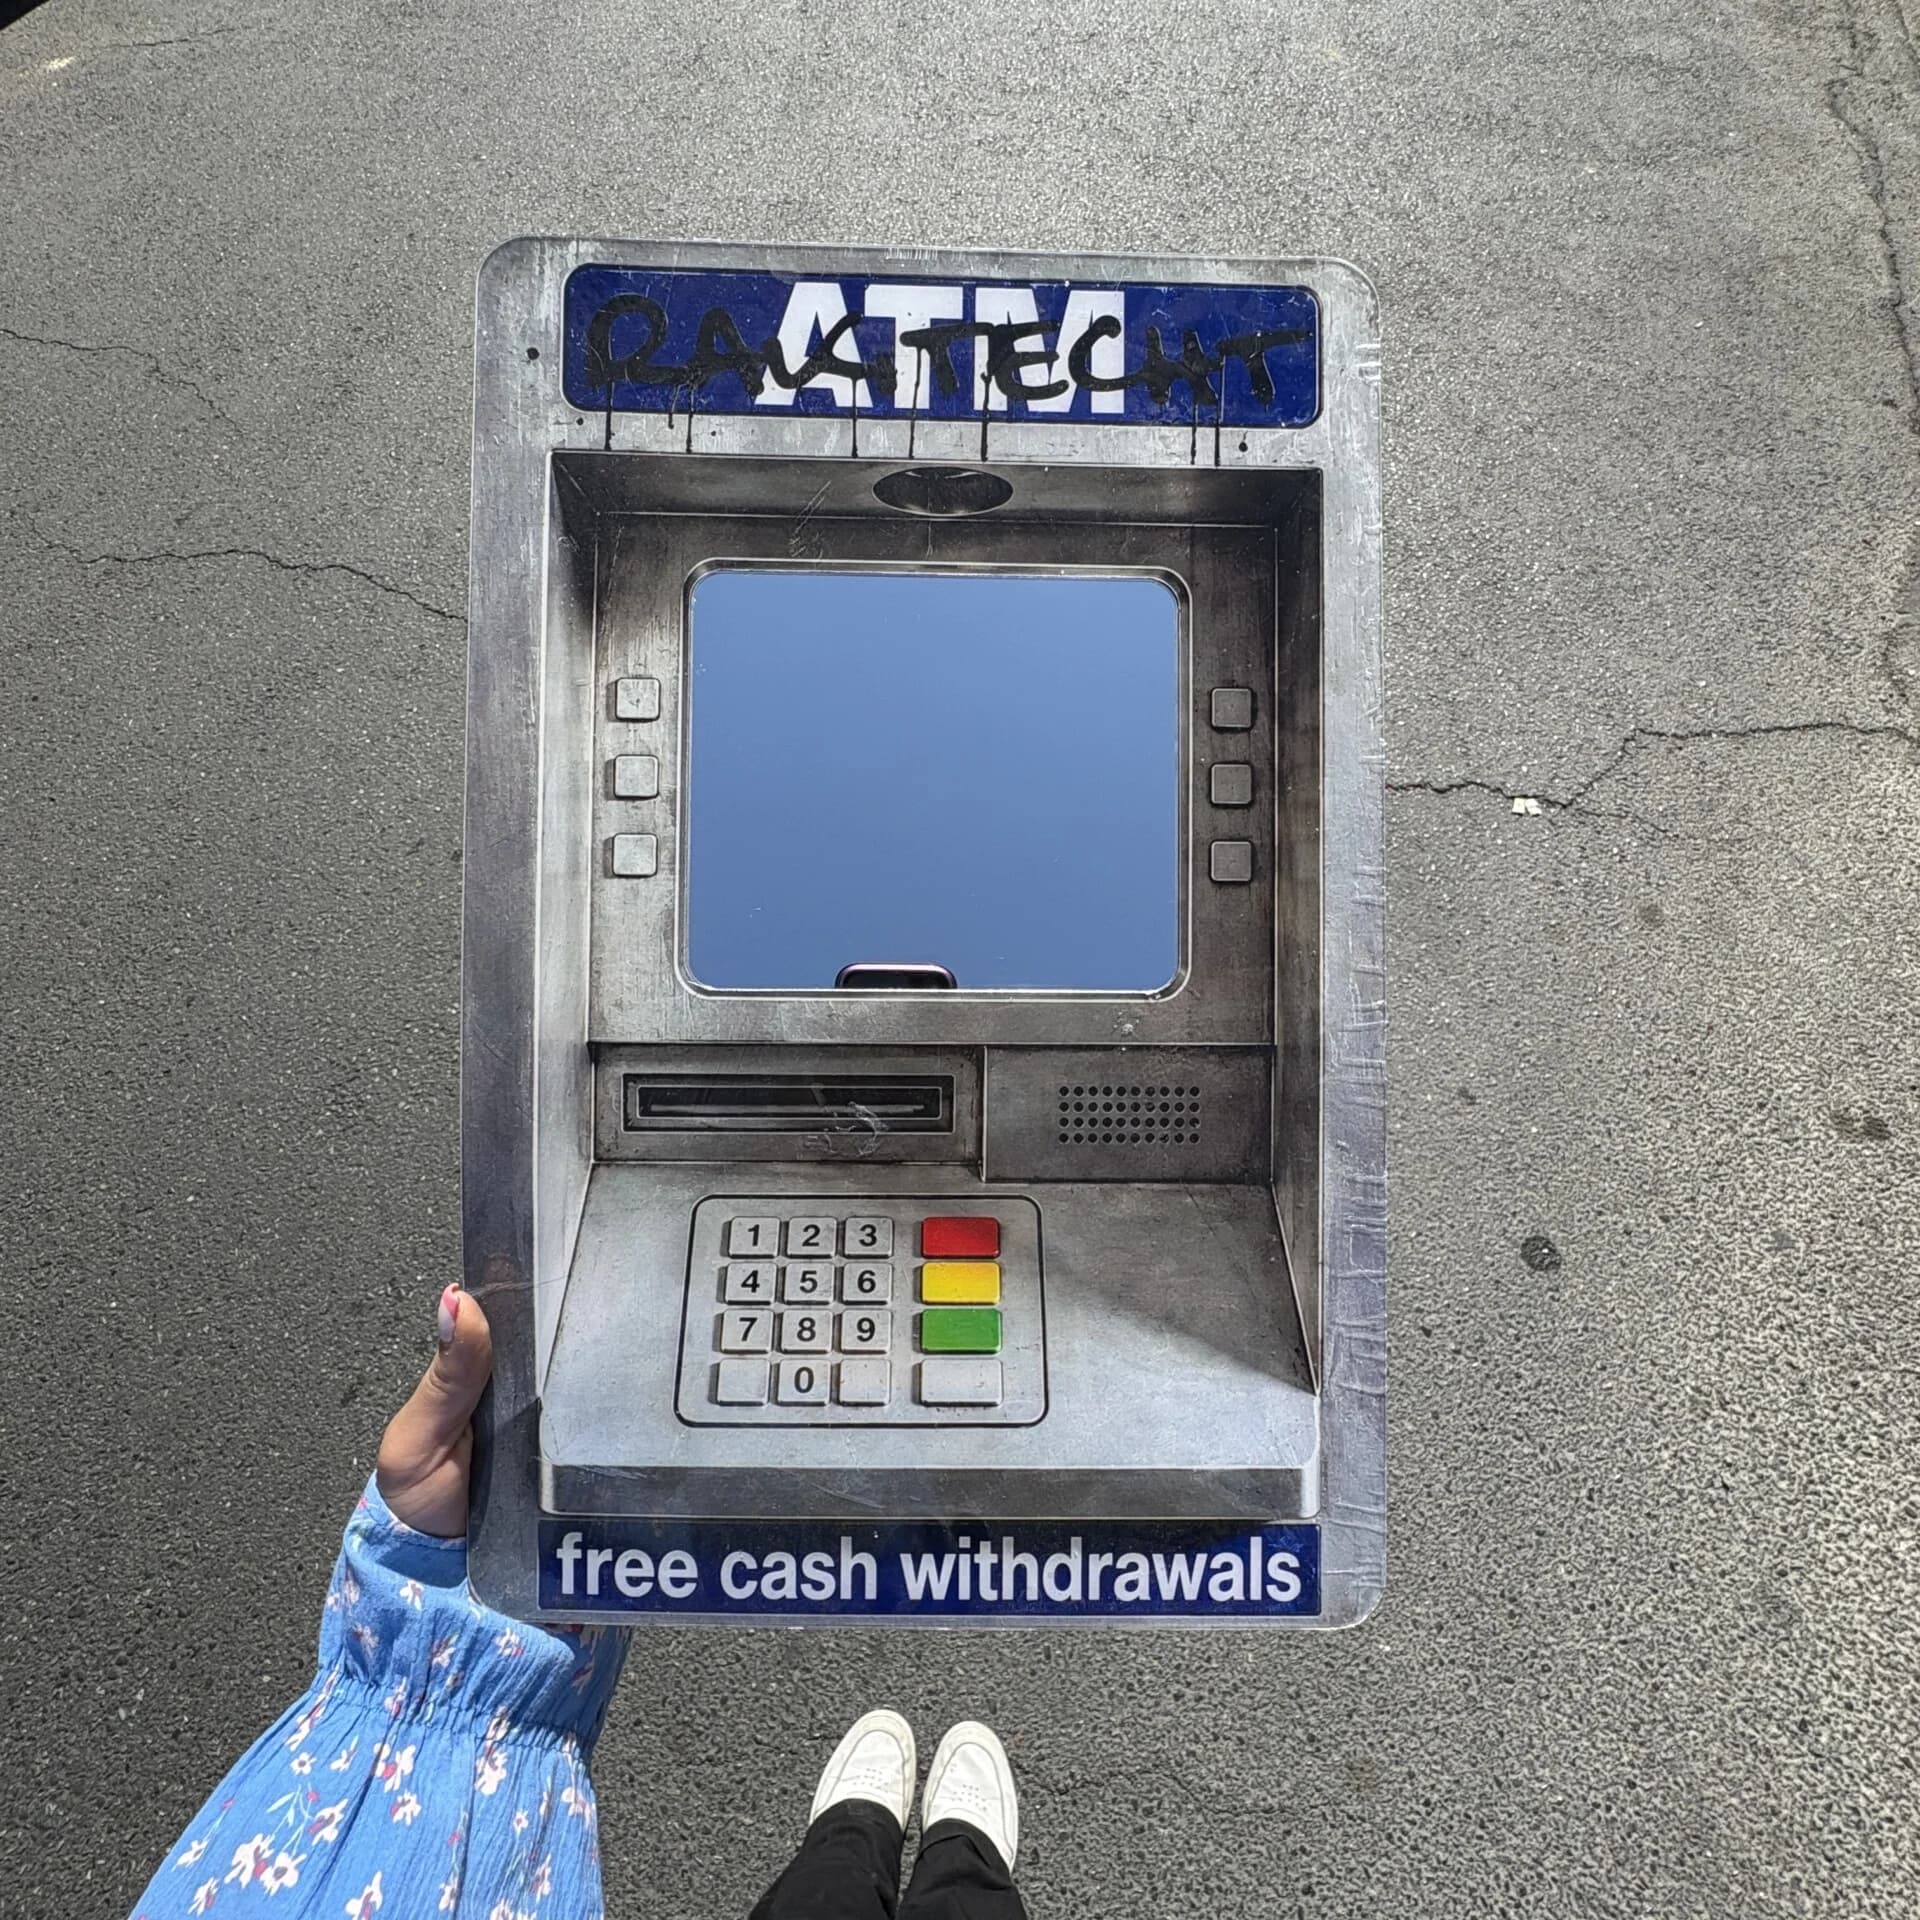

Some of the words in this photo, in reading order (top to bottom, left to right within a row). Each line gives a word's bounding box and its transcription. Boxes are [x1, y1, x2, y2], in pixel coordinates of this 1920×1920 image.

[755, 281, 1125, 413] ATM
[747, 1223, 760, 1247] 1
[801, 1223, 821, 1247] 2
[858, 1223, 878, 1248] 3
[740, 1269, 761, 1294] 4
[799, 1270, 818, 1294] 5
[857, 1269, 877, 1294] 6
[739, 1316, 758, 1342] 7
[796, 1316, 817, 1342] 8
[856, 1317, 876, 1343] 9
[794, 1366, 814, 1394] 0
[556, 1532, 698, 1598] free
[719, 1535, 877, 1601] cash
[899, 1536, 1302, 1602] withdrawals
